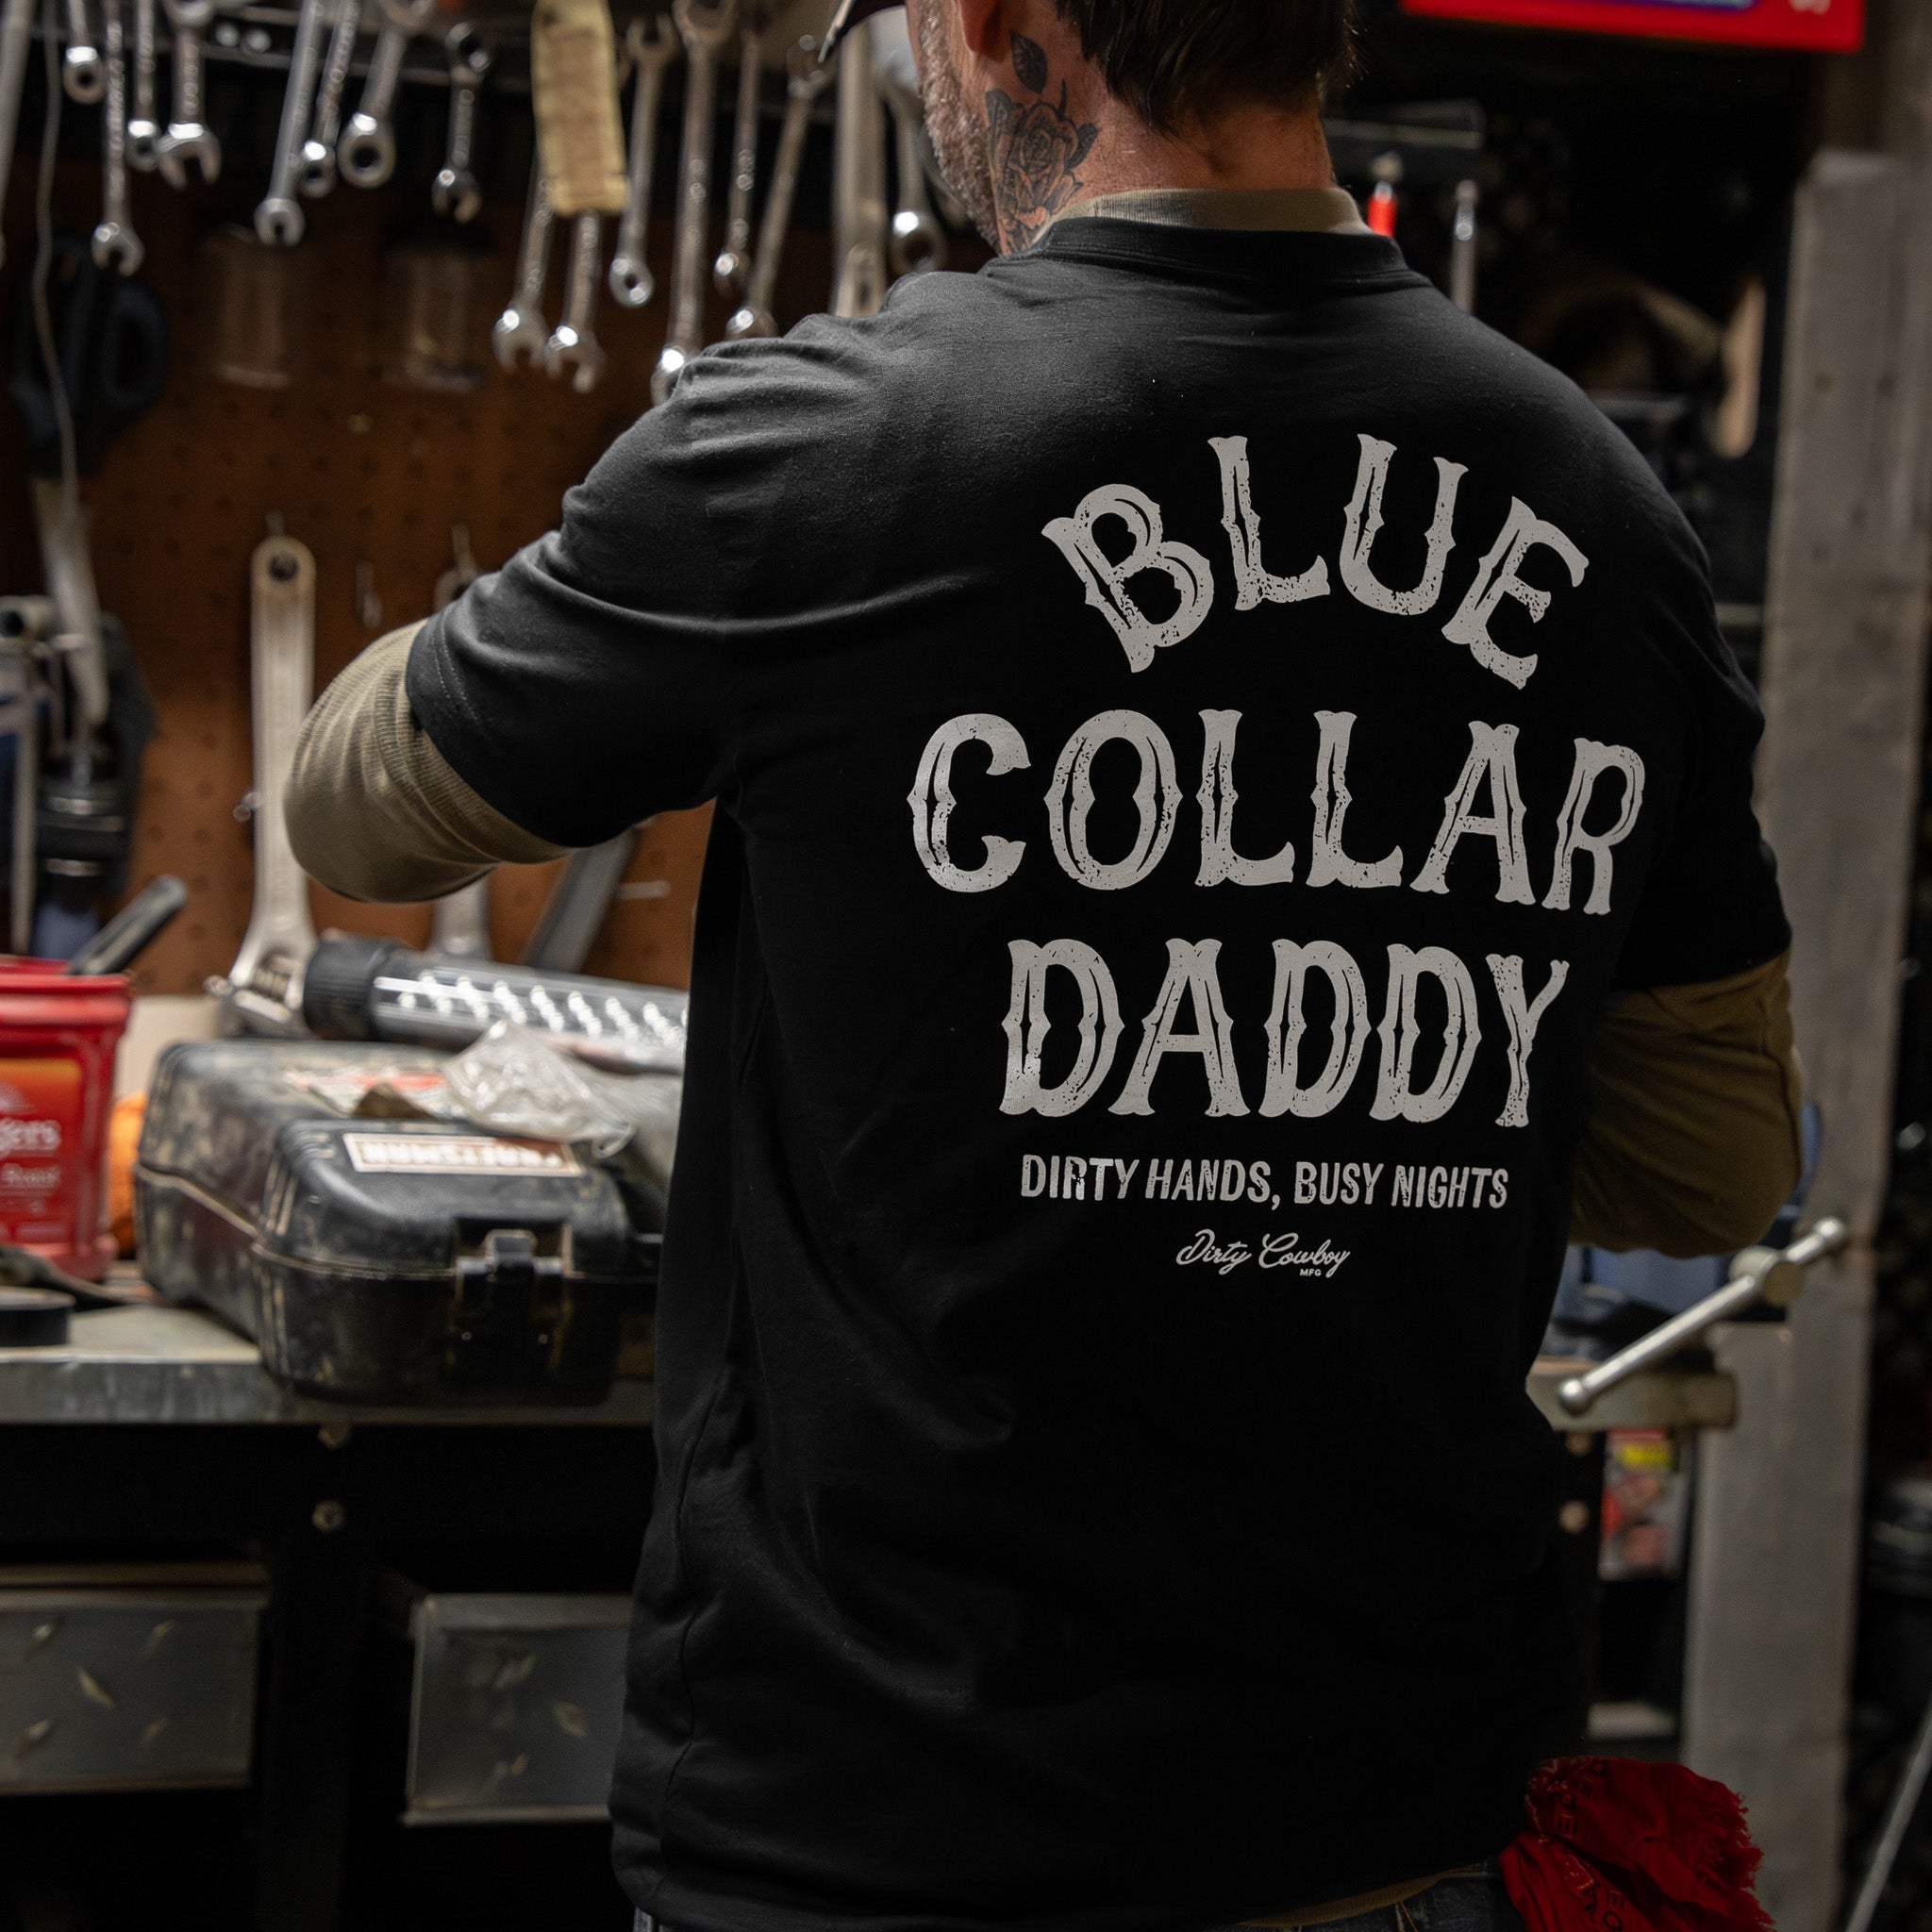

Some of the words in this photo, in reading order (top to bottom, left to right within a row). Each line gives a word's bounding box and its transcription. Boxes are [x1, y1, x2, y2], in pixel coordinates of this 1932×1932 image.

[1041, 434, 1589, 690] BLUE
[907, 709, 1645, 915] COLLAR
[999, 939, 1570, 1128] DADDY
[1021, 1154, 1140, 1200] DIRTY
[1144, 1158, 1281, 1211] HANDS,
[1293, 1161, 1385, 1205] BUSY
[1391, 1165, 1508, 1208] NIGHTS
[1175, 1228, 1253, 1275] Dirty
[1258, 1232, 1351, 1278] Cowboy
[1299, 1268, 1322, 1276] MFG
